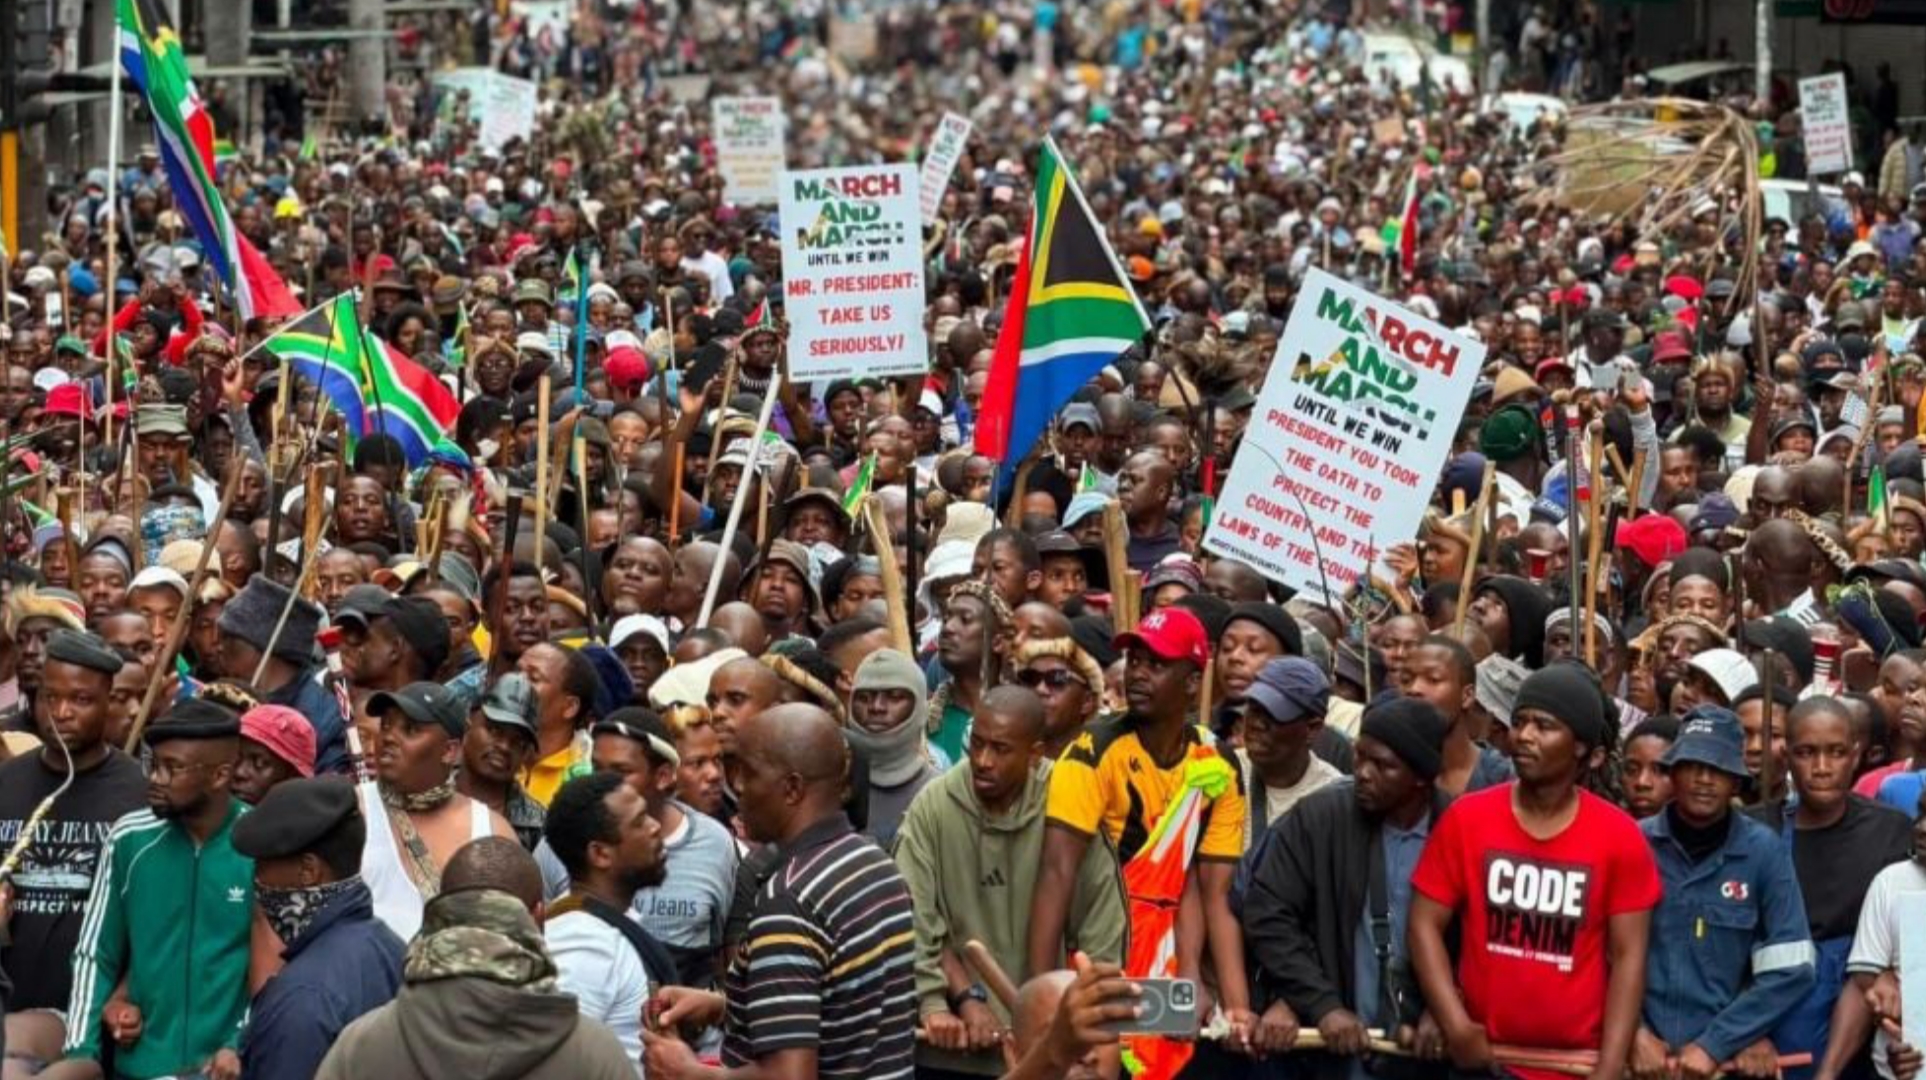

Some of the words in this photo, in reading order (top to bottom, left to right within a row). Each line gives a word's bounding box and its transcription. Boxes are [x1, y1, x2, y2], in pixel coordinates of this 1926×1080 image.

[794, 173, 902, 201] MARCH
[821, 201, 881, 224] AND
[797, 221, 904, 250] MARCH
[808, 253, 842, 266] UNTIL
[846, 252, 864, 264] WE
[868, 250, 890, 263] WIN
[788, 279, 817, 297] MR.
[823, 272, 919, 294] PRESIDENT:
[818, 307, 864, 325] TAKE
[871, 305, 892, 321] US
[1316, 287, 1461, 378] MARCH
[1329, 336, 1418, 392] AND
[1291, 352, 1436, 441] MARCH
[1293, 394, 1338, 426] UNTIL
[1344, 415, 1369, 439] WE
[1371, 428, 1402, 454] WIN
[1267, 408, 1347, 454] PRESIDENT
[1351, 446, 1379, 469] YOU
[1383, 460, 1421, 488] TOOK
[1285, 447, 1316, 472] THE
[1318, 463, 1359, 492] OATH
[1363, 482, 1383, 502] TO
[1245, 493, 1313, 533] COUNTRY
[1317, 526, 1347, 548] AND
[1352, 539, 1380, 564] THE
[1273, 474, 1341, 514] PROTECT
[1344, 505, 1374, 529] THE
[1218, 512, 1260, 541] LAWS
[1263, 532, 1284, 551] OF
[1286, 542, 1316, 567] THE
[1320, 557, 1359, 585] COUN
[53, 820, 111, 844] JEAN
[648, 894, 698, 917] Jeans
[1487, 858, 1586, 917] CODE
[1487, 906, 1578, 957] DENIM
